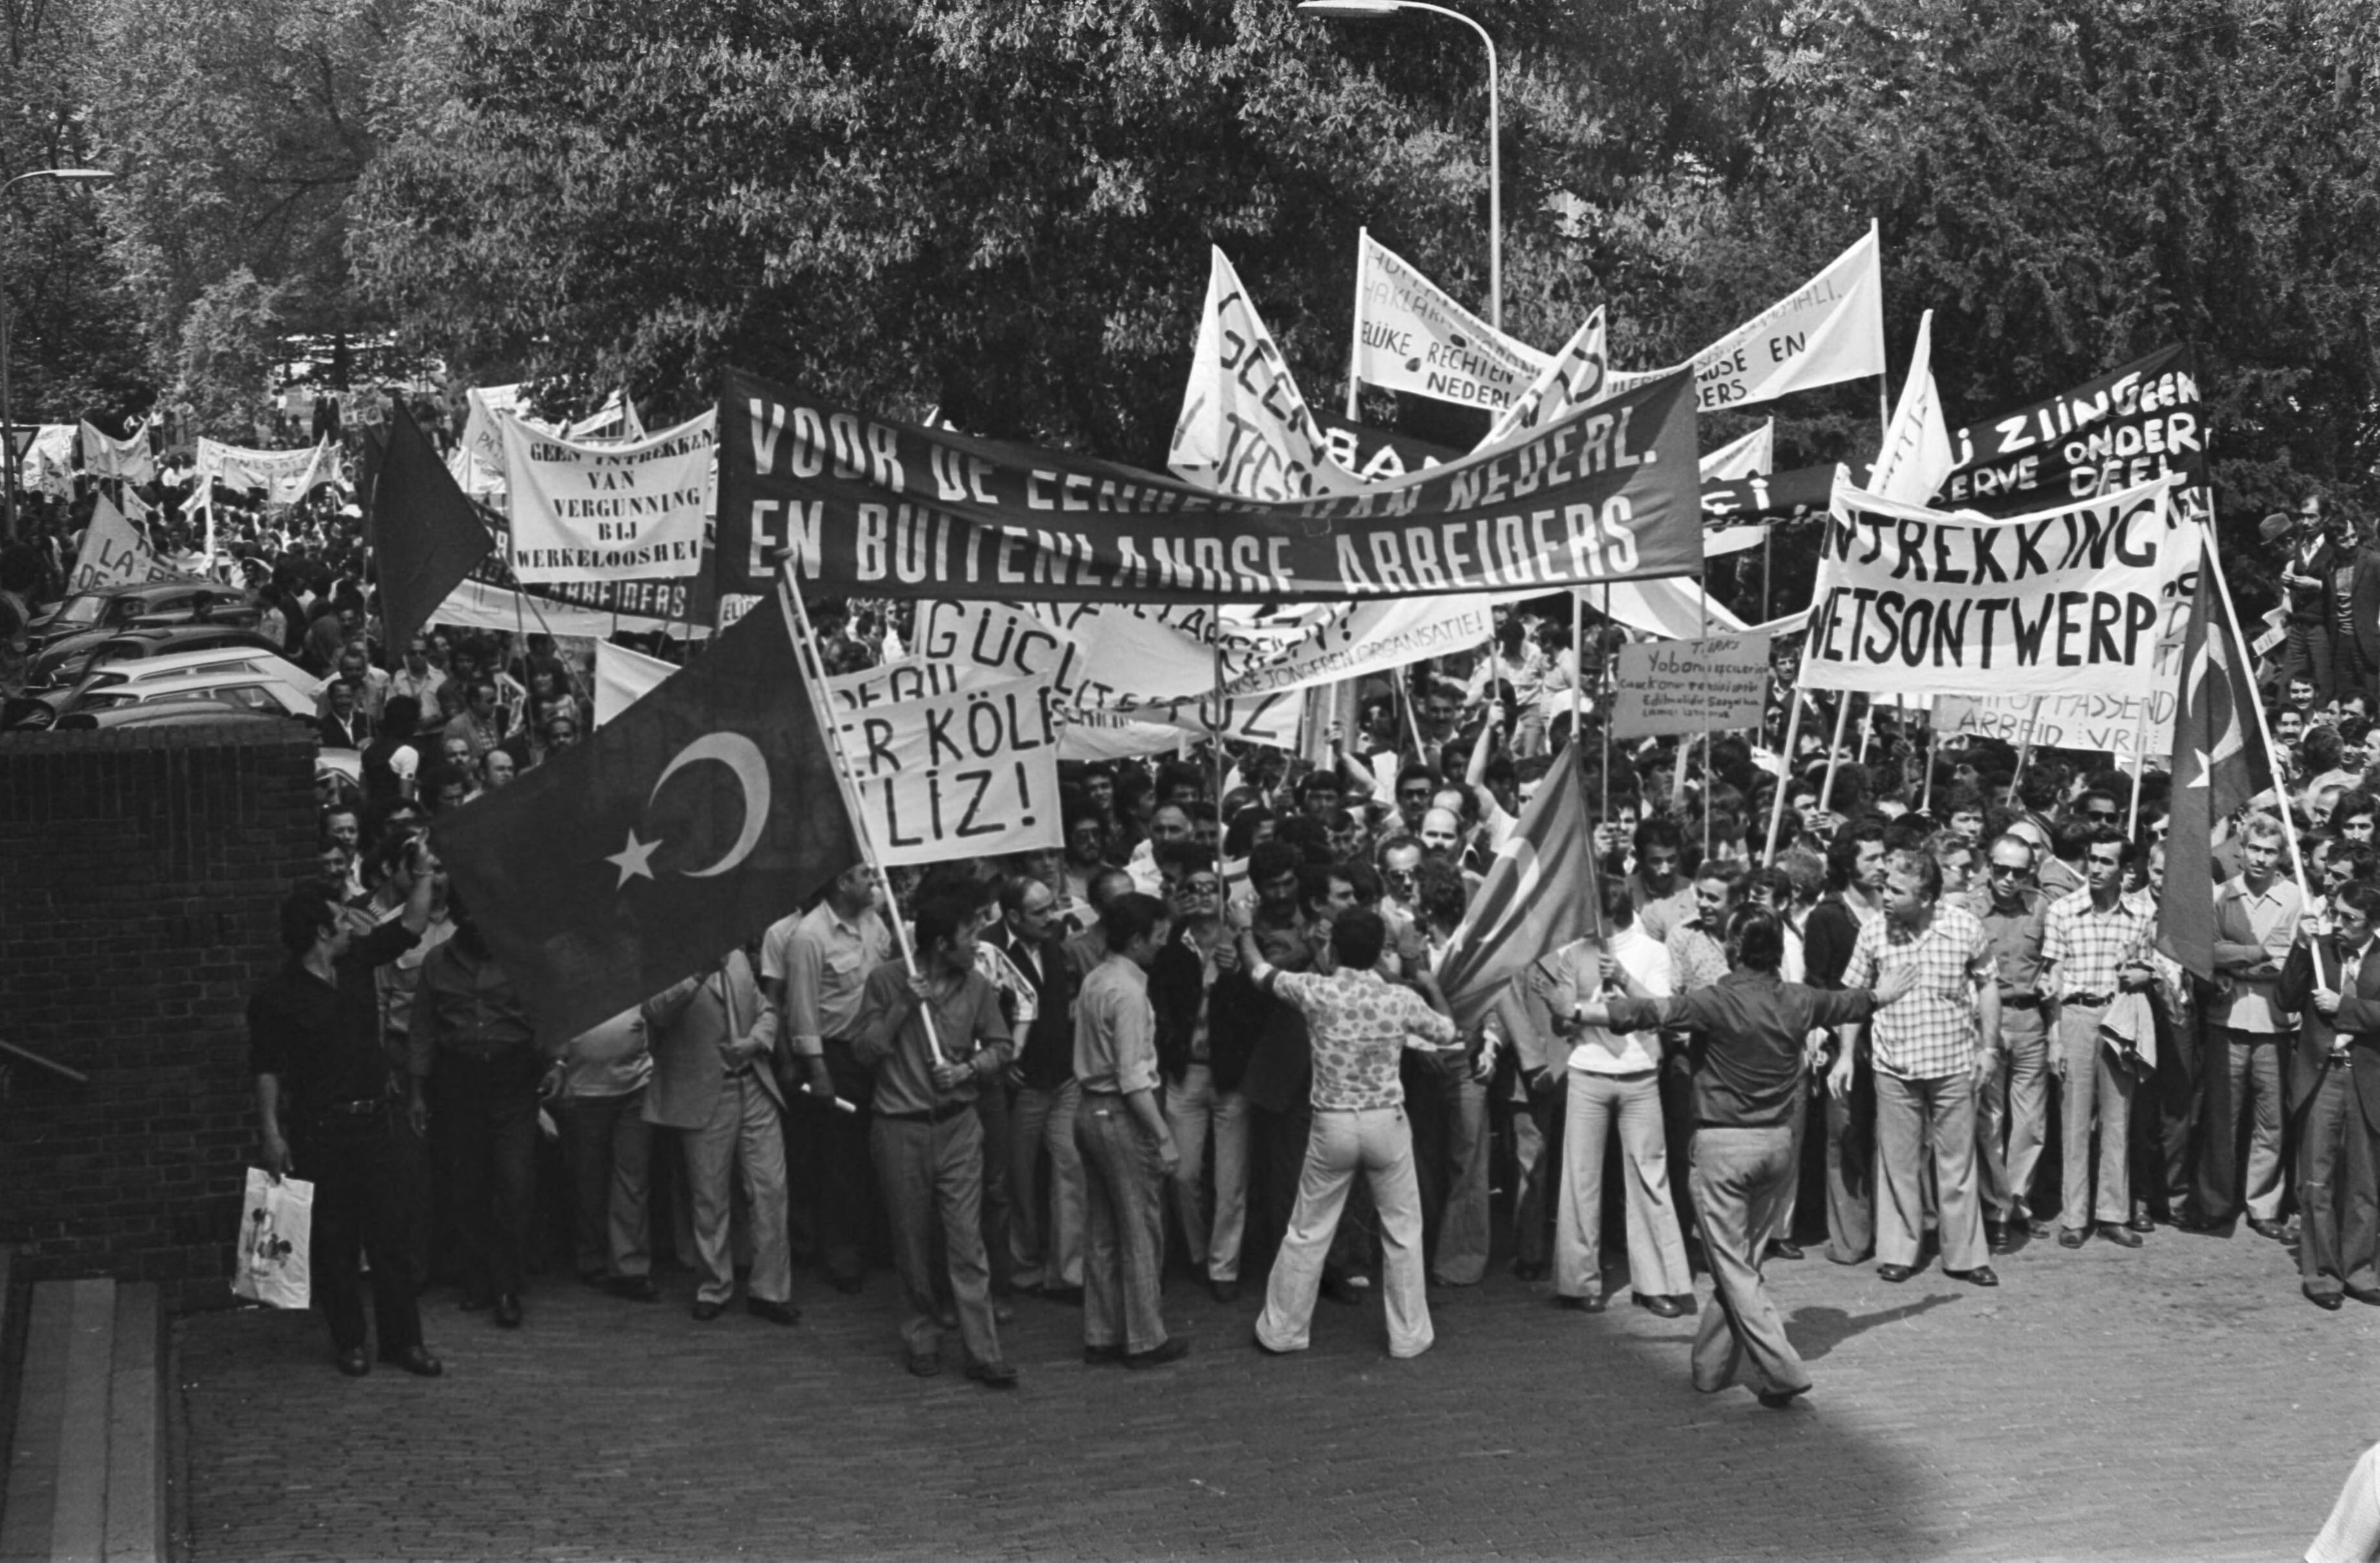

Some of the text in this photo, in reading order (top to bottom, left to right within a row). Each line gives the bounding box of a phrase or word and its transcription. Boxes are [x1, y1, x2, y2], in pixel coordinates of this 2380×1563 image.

[1427, 342, 1514, 384] RECHTEN
[1769, 331, 1806, 362] EN
[2112, 370, 2199, 416] GEEN
[530, 442, 581, 462] GEEN
[749, 398, 904, 493] VOOR
[931, 443, 999, 504] DE
[1443, 405, 1657, 513] NEDERL.
[2064, 412, 2202, 465] ONDER
[587, 470, 635, 490] VAN
[553, 487, 701, 518] VERGUNNING
[598, 521, 637, 540] BIJ
[749, 500, 823, 579] EN
[1335, 495, 1639, 594] ARBEIDERS
[1958, 708, 2063, 748] ARBEID
